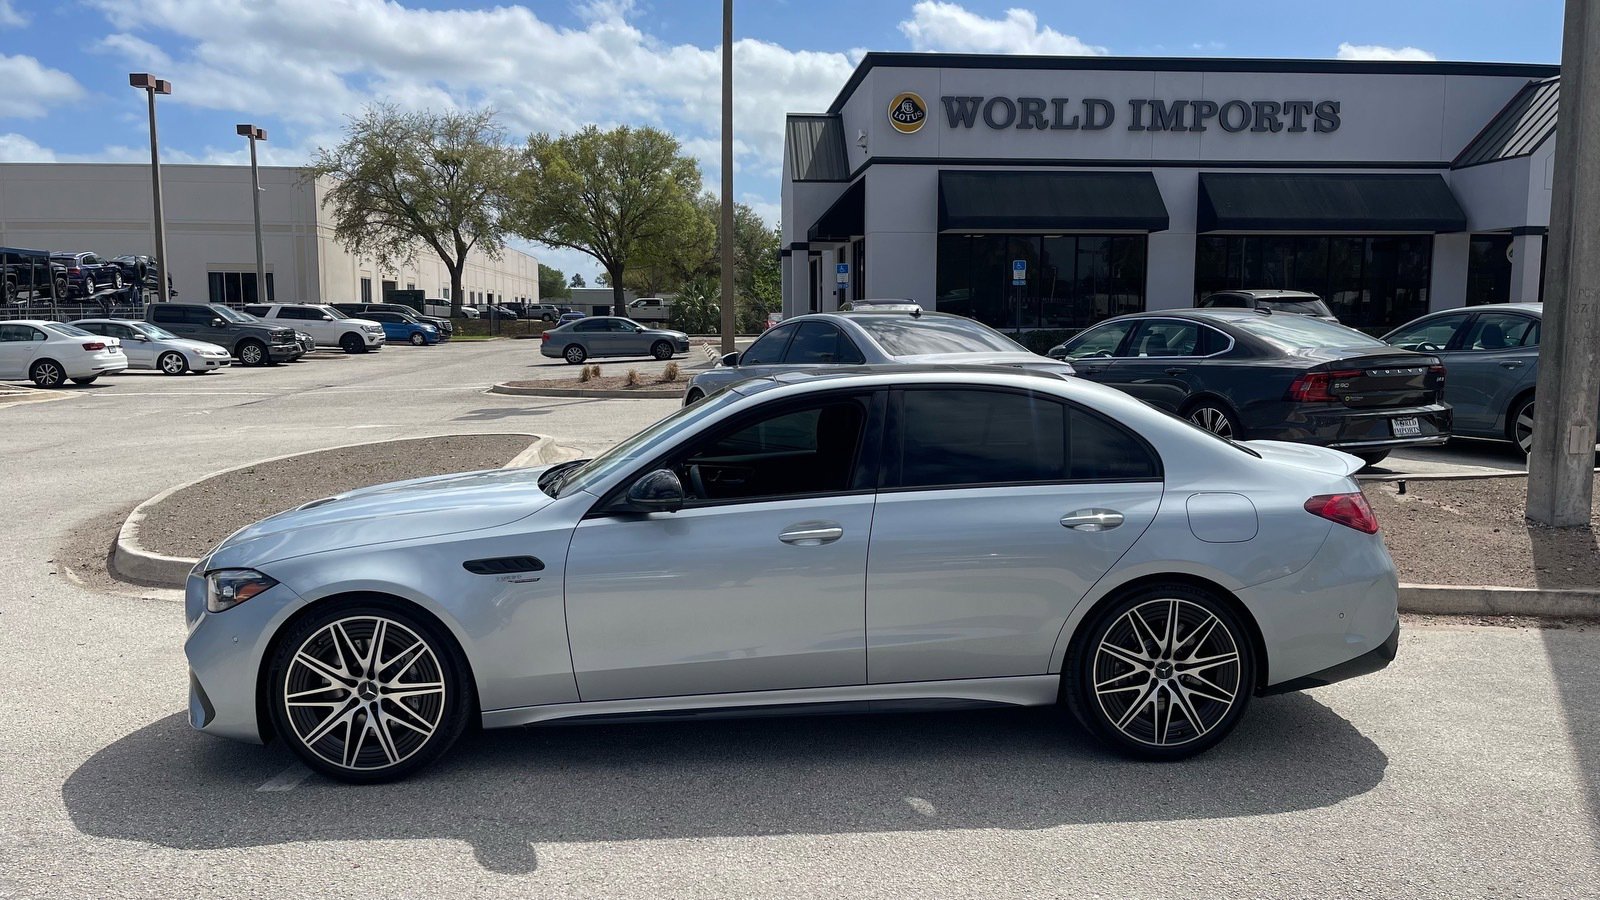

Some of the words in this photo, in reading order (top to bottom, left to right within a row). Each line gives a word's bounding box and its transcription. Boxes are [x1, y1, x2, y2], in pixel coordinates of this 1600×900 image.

[893, 110, 923, 121] LOTUS
[941, 96, 1116, 131] WORLD
[1126, 99, 1342, 133] IMPORTS
[1371, 367, 1424, 375] VOLVO
[1394, 419, 1417, 427] WORLD
[1394, 426, 1421, 434] IMPORTS
